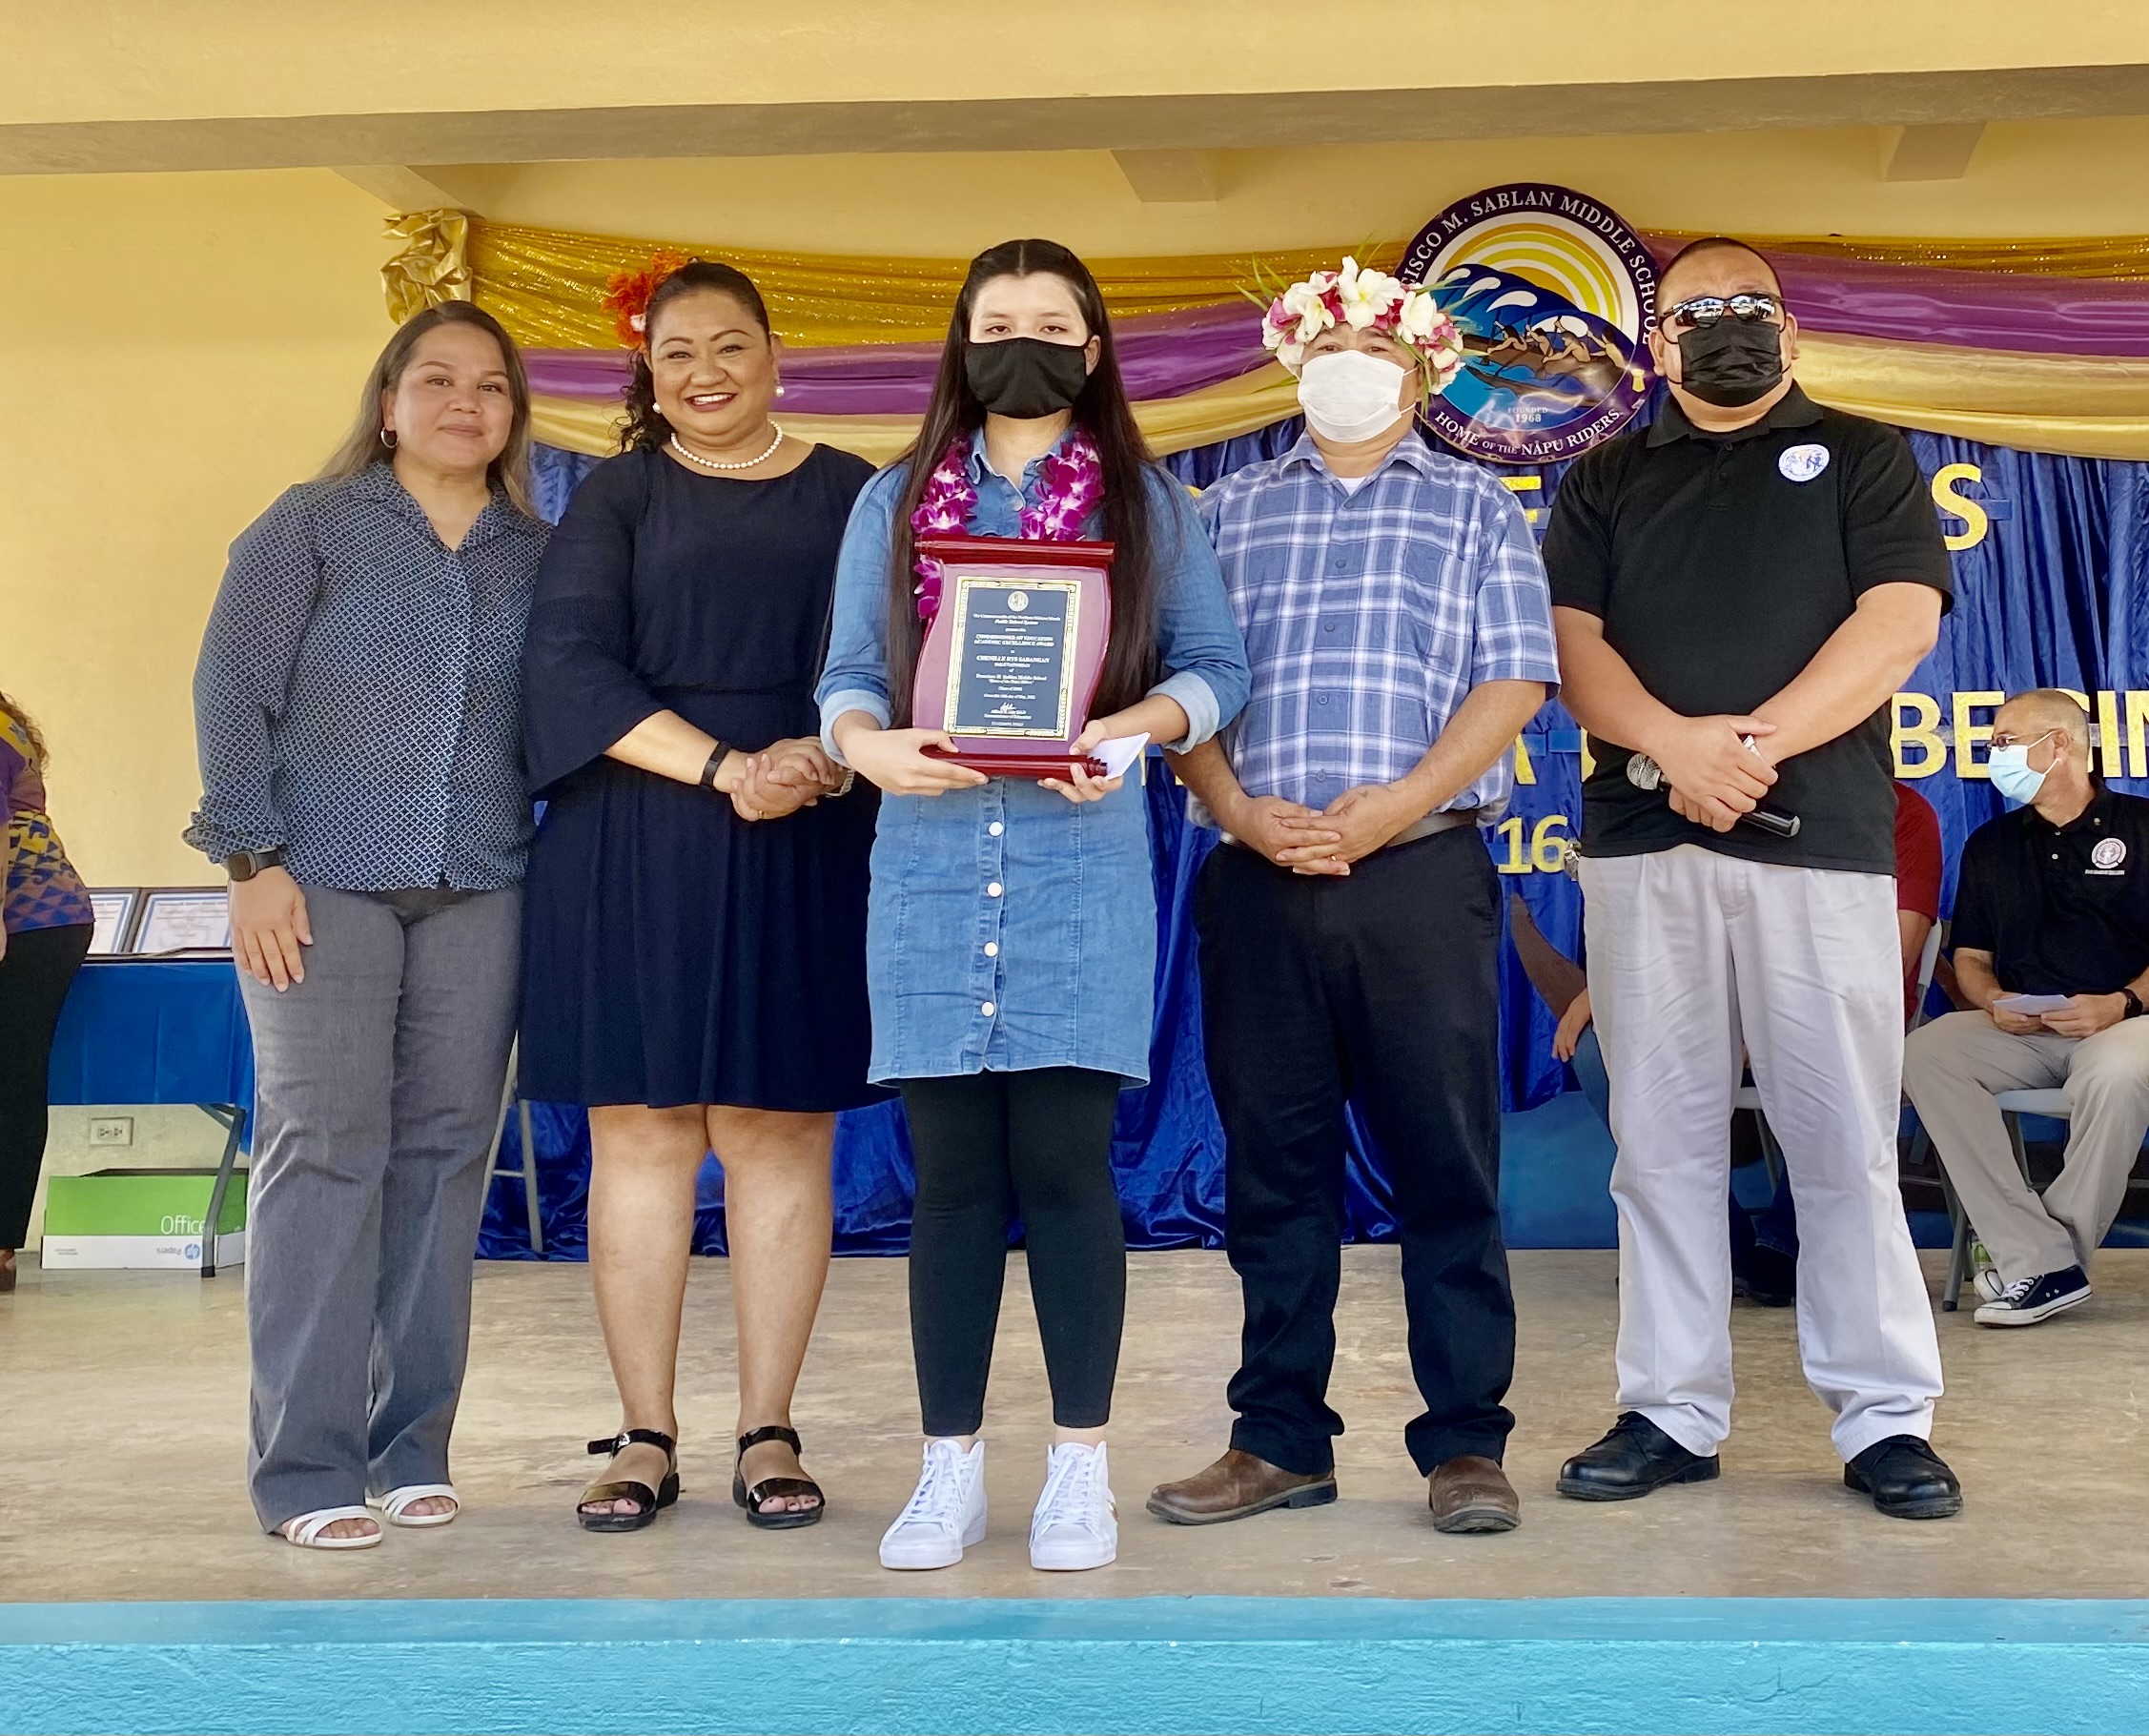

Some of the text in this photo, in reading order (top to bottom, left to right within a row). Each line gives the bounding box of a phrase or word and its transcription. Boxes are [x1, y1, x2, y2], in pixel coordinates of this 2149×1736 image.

[1441, 212, 1468, 235] M.
[1470, 190, 1555, 217] SABLAN
[1559, 195, 1636, 255] MIDDLE
[1628, 255, 1659, 345] SCHOOL
[1434, 411, 1480, 446] HOME
[1483, 440, 1496, 450] OF
[1498, 444, 1518, 456] THE
[1566, 408, 1621, 448] RIDERS
[1515, 414, 1542, 423] 1968
[1890, 688, 2149, 778] BEI
[1498, 814, 1569, 873] 16
[161, 1215, 206, 1236] Office
